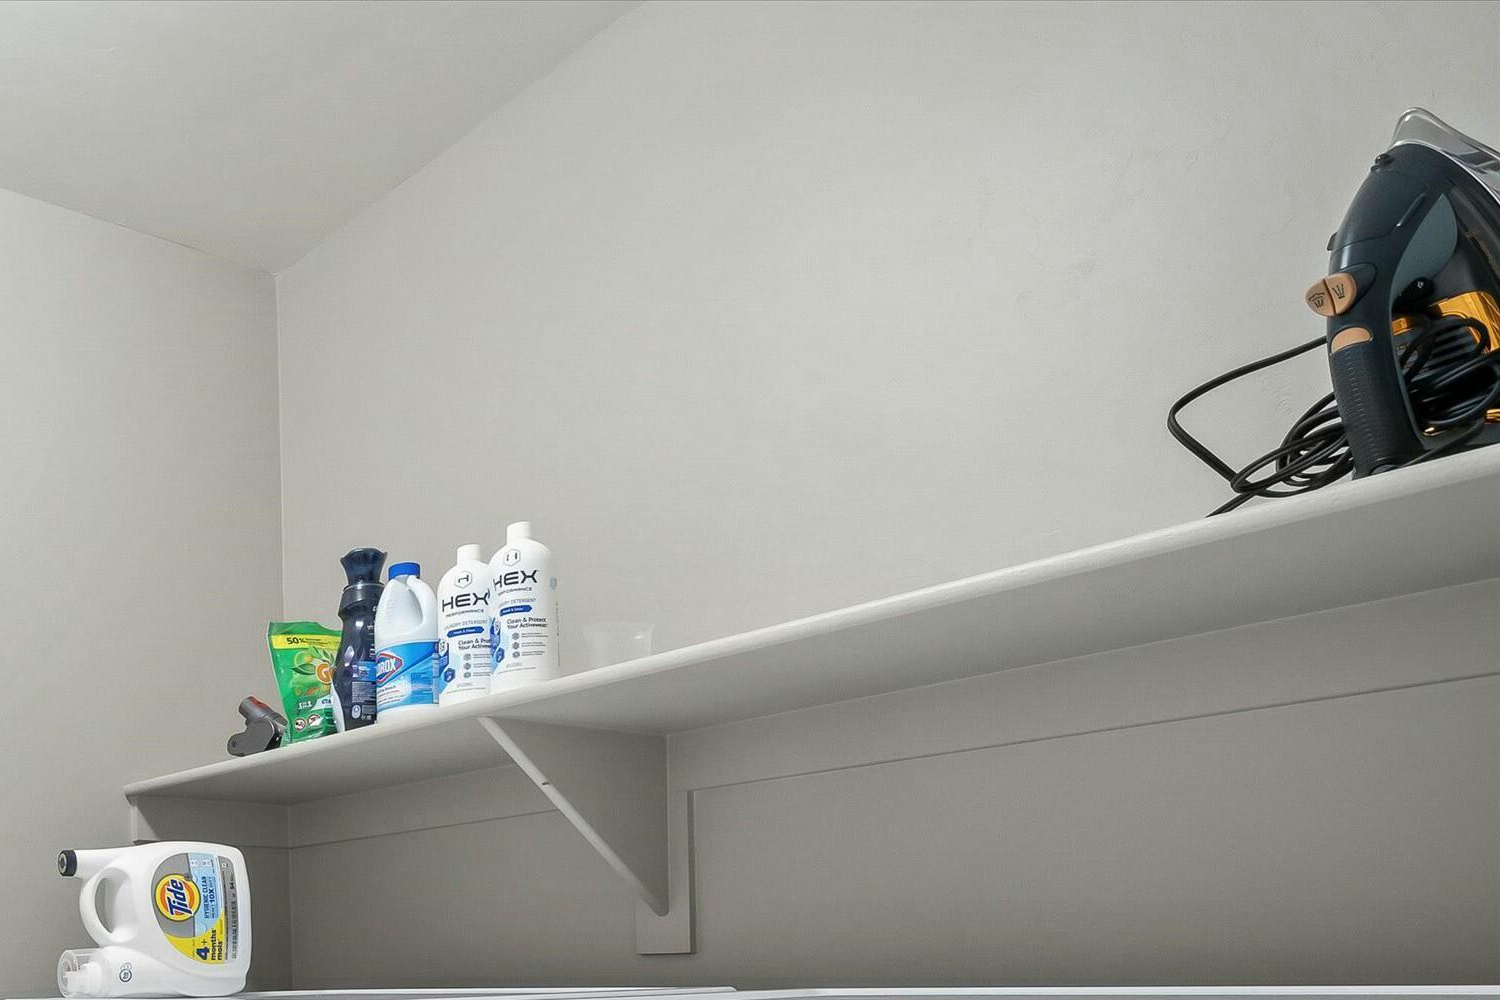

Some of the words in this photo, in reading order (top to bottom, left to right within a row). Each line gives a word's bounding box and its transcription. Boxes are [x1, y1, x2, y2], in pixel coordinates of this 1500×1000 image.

[493, 569, 538, 591] HEX
[442, 592, 489, 612] HEX
[167, 879, 192, 916] Tide
